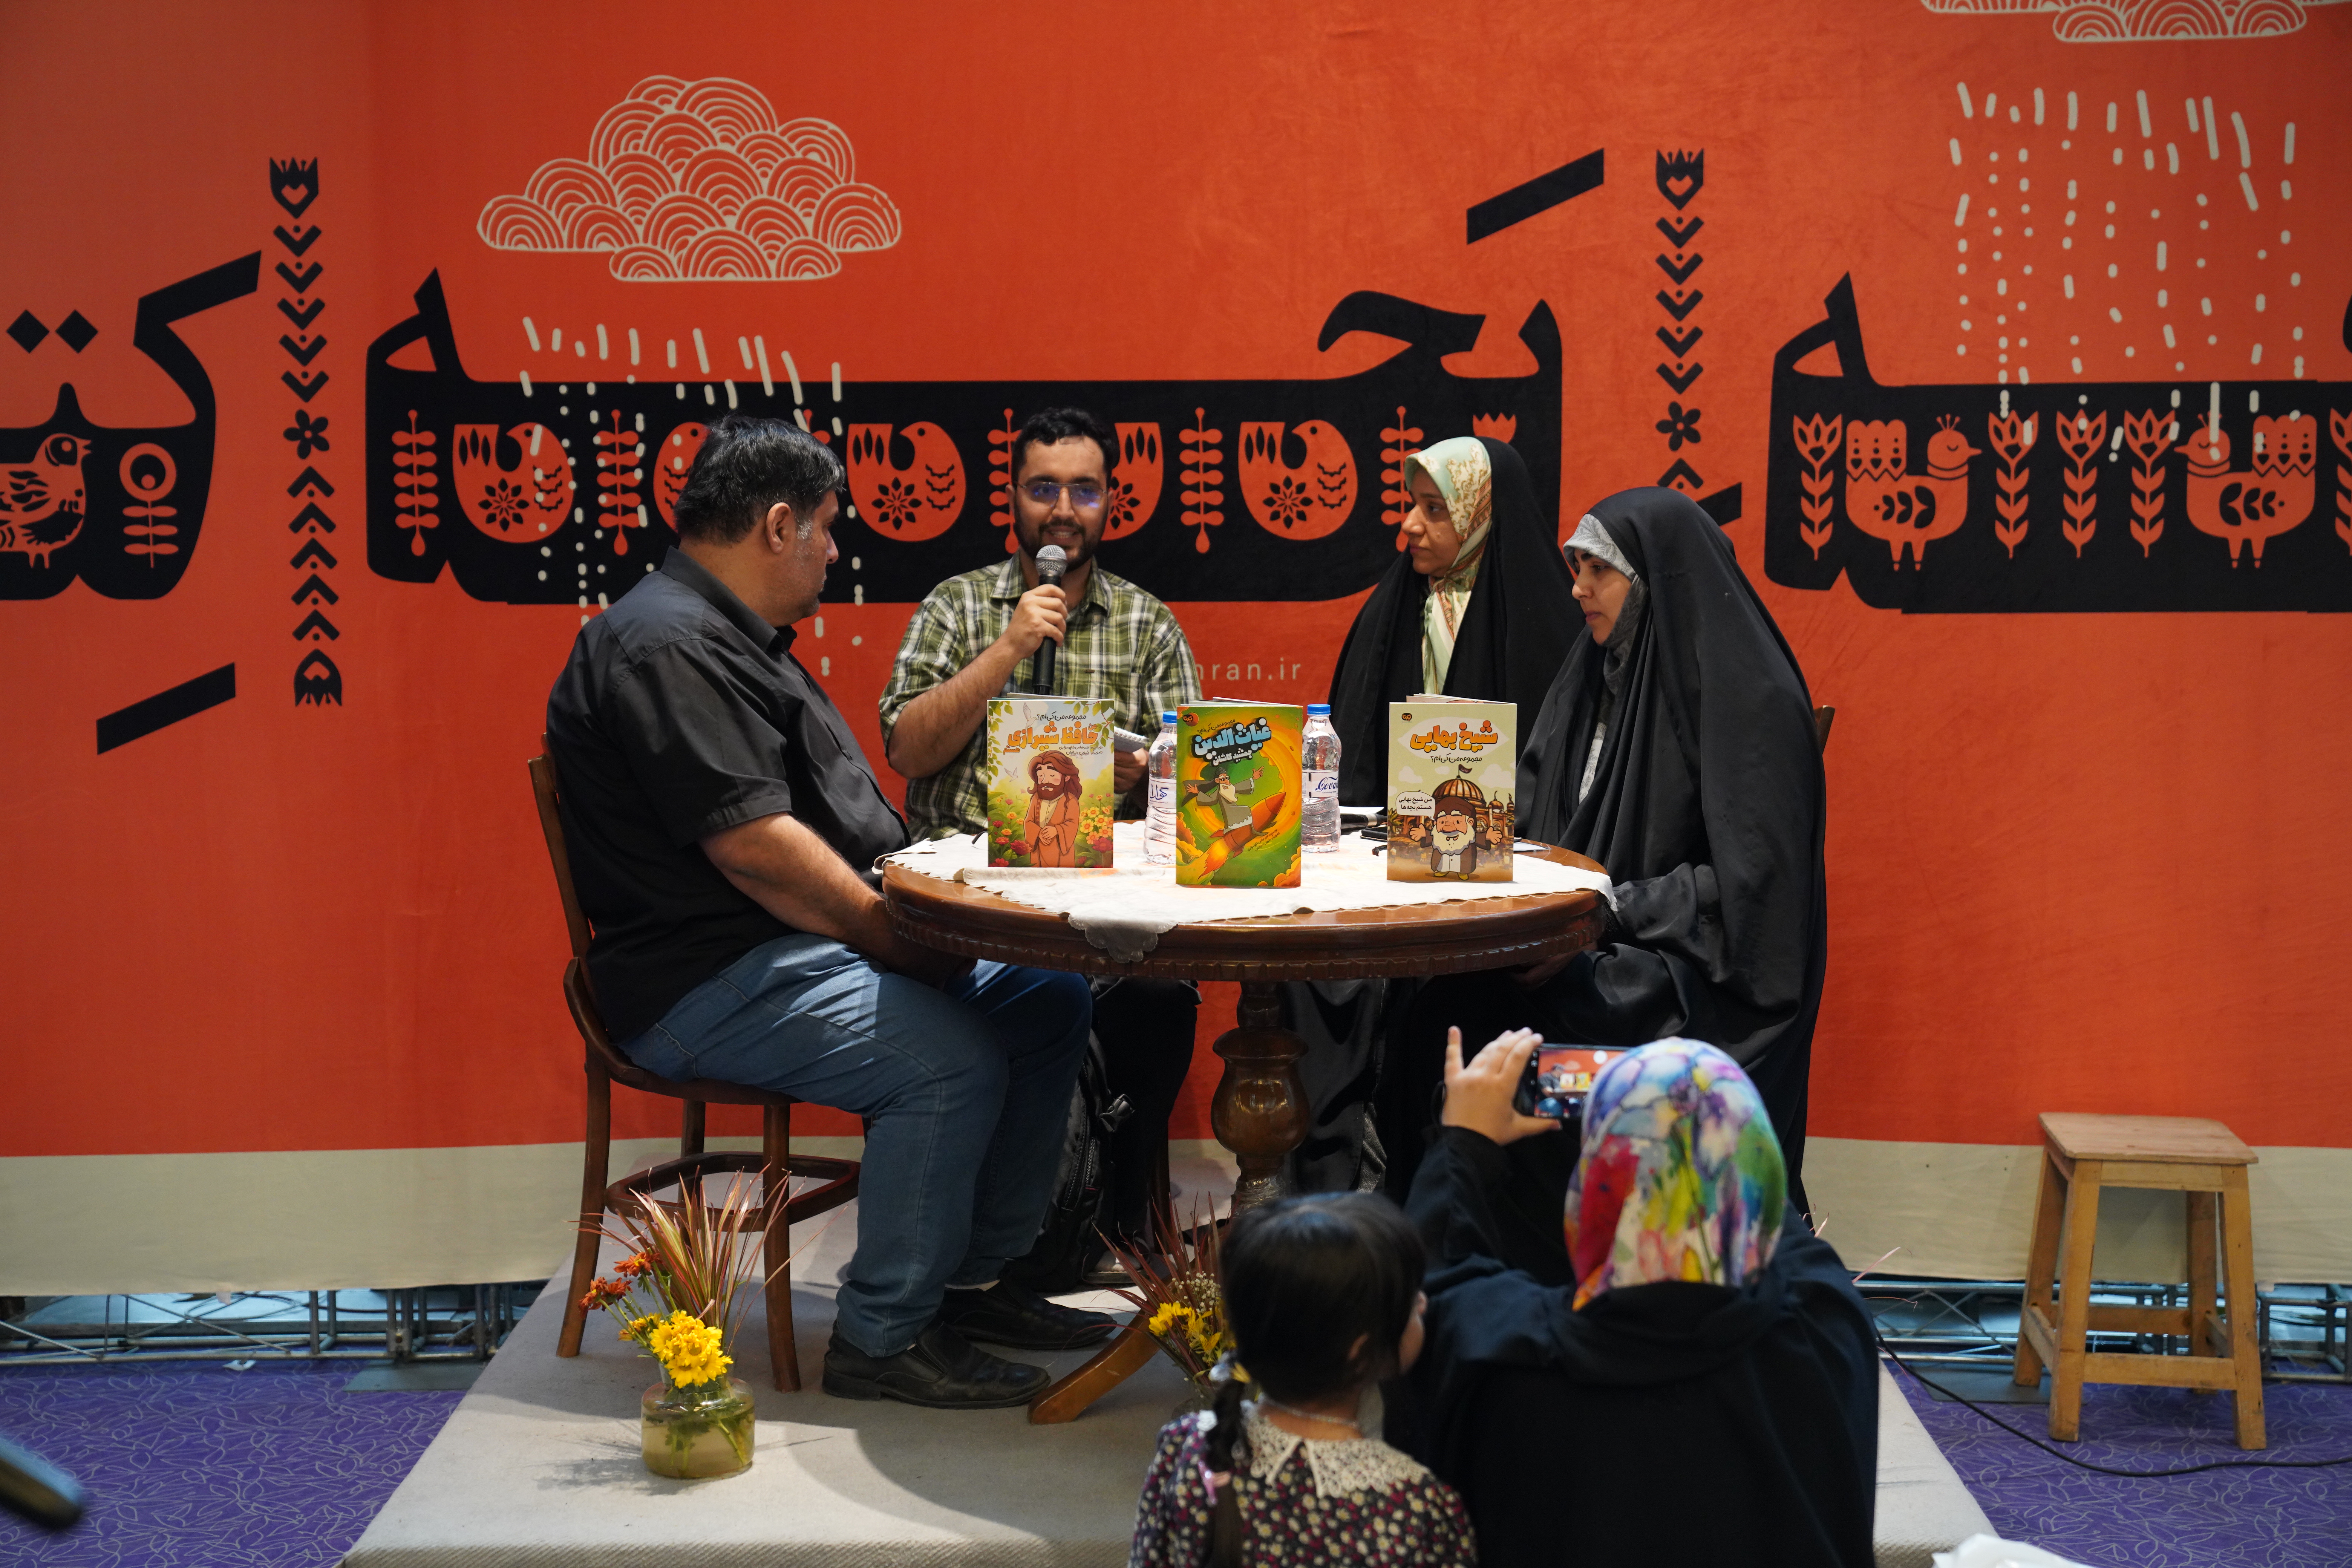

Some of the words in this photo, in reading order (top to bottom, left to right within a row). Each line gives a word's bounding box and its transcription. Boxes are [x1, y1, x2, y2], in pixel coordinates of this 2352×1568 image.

[1007, 720, 1060, 751] شیرازی
[1060, 721, 1098, 744] حافظ
[1194, 728, 1235, 760] الدین
[1234, 718, 1271, 750] غیاث
[1410, 725, 1458, 753] بهایی
[1459, 720, 1498, 752] شیخ
[1003, 745, 1020, 755] هستم
[1213, 753, 1232, 766] کاشانی
[1233, 747, 1252, 762] جمشید
[1150, 783, 1169, 800] گوارا
